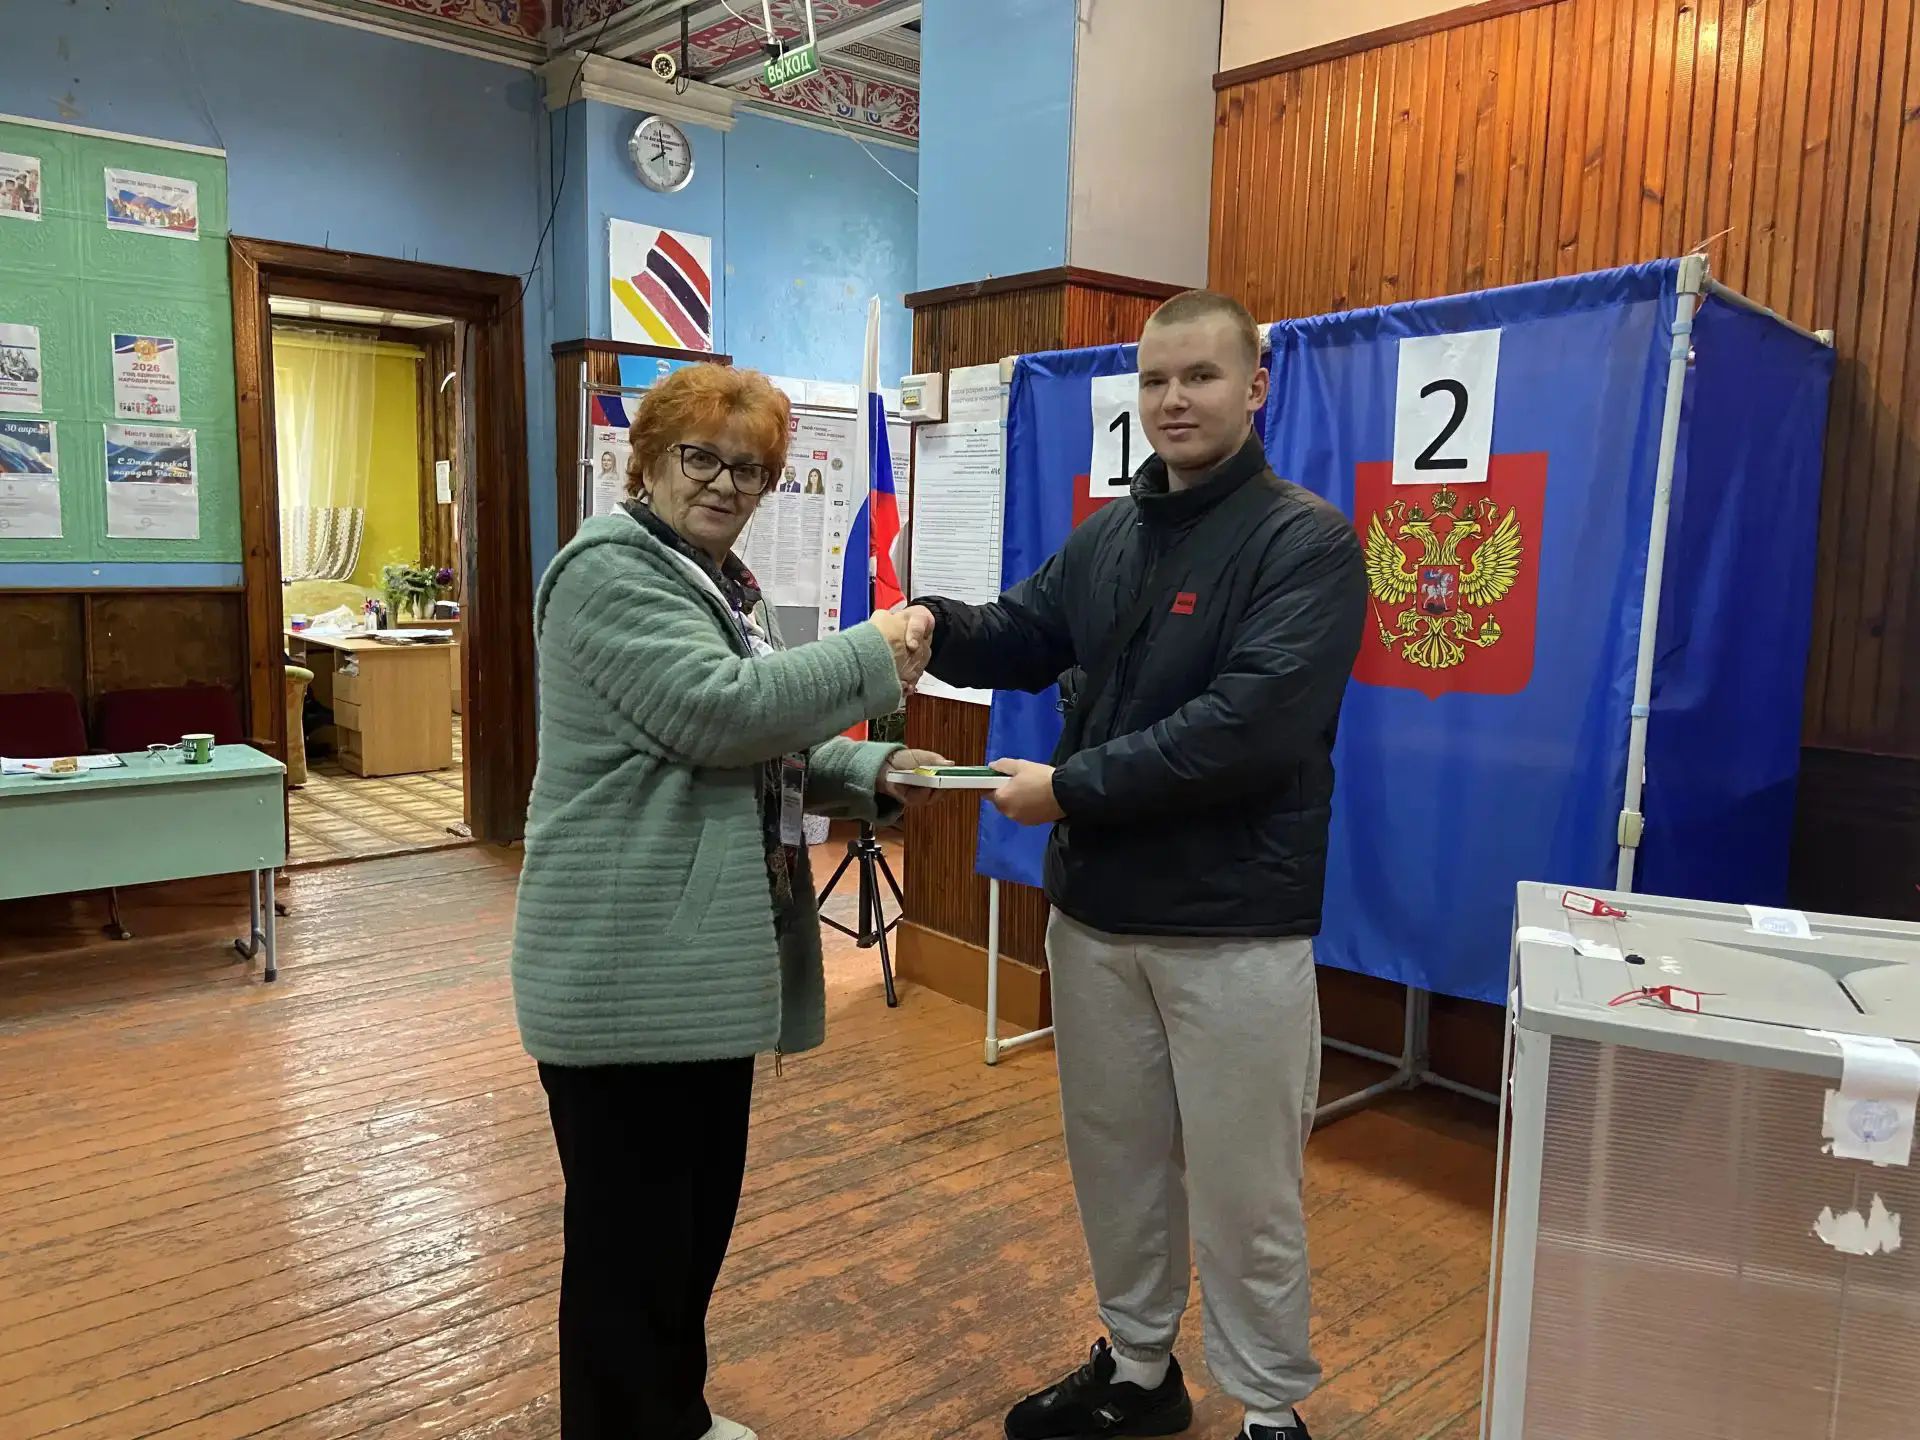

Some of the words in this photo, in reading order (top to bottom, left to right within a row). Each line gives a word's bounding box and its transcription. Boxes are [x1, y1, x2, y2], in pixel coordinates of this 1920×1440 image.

[767, 51, 812, 83] ВЫХОД
[132, 362, 160, 372] 2026
[4, 424, 17, 432] 30
[1414, 379, 1468, 470] 2
[1108, 411, 1133, 486] 1
